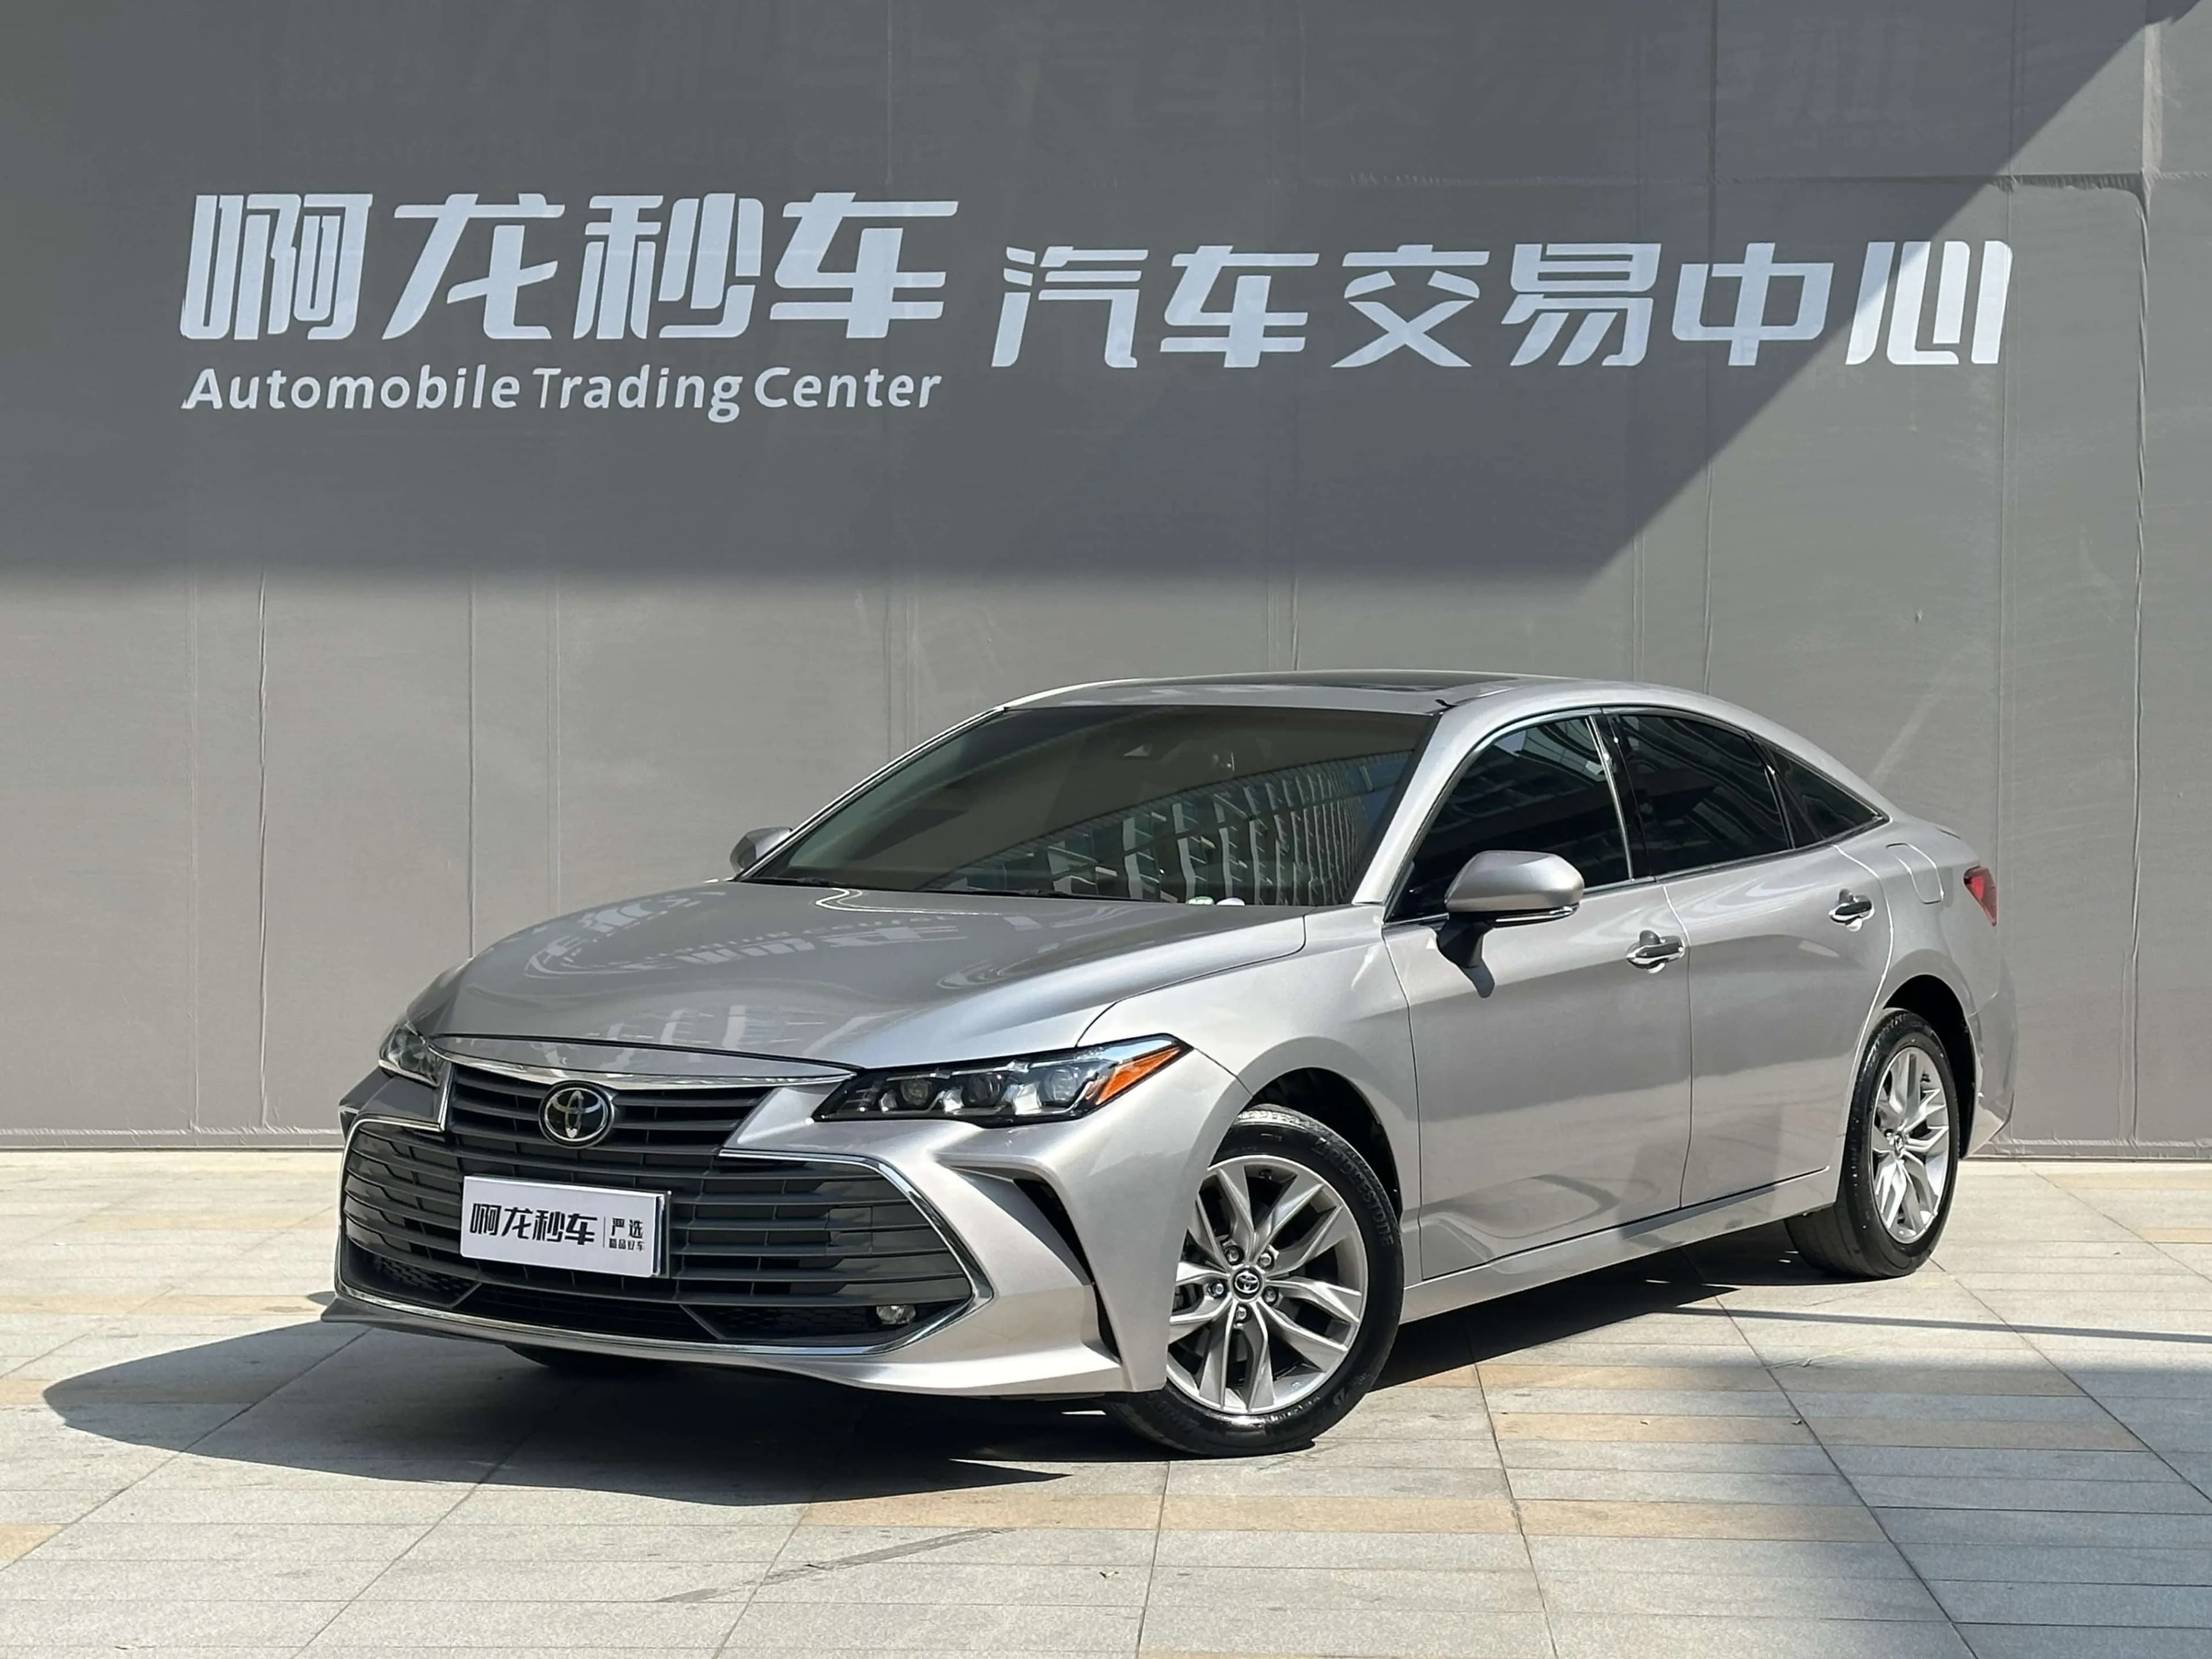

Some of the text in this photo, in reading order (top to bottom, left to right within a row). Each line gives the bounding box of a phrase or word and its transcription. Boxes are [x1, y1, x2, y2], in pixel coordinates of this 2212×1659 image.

[180, 192, 959, 340] 啊龙秒车
[991, 241, 2013, 368] 汽车交易中心
[181, 365, 942, 423] Automobile Trading Center
[469, 1203, 598, 1245] 啊龙秒车
[611, 1218, 643, 1239] 严选
